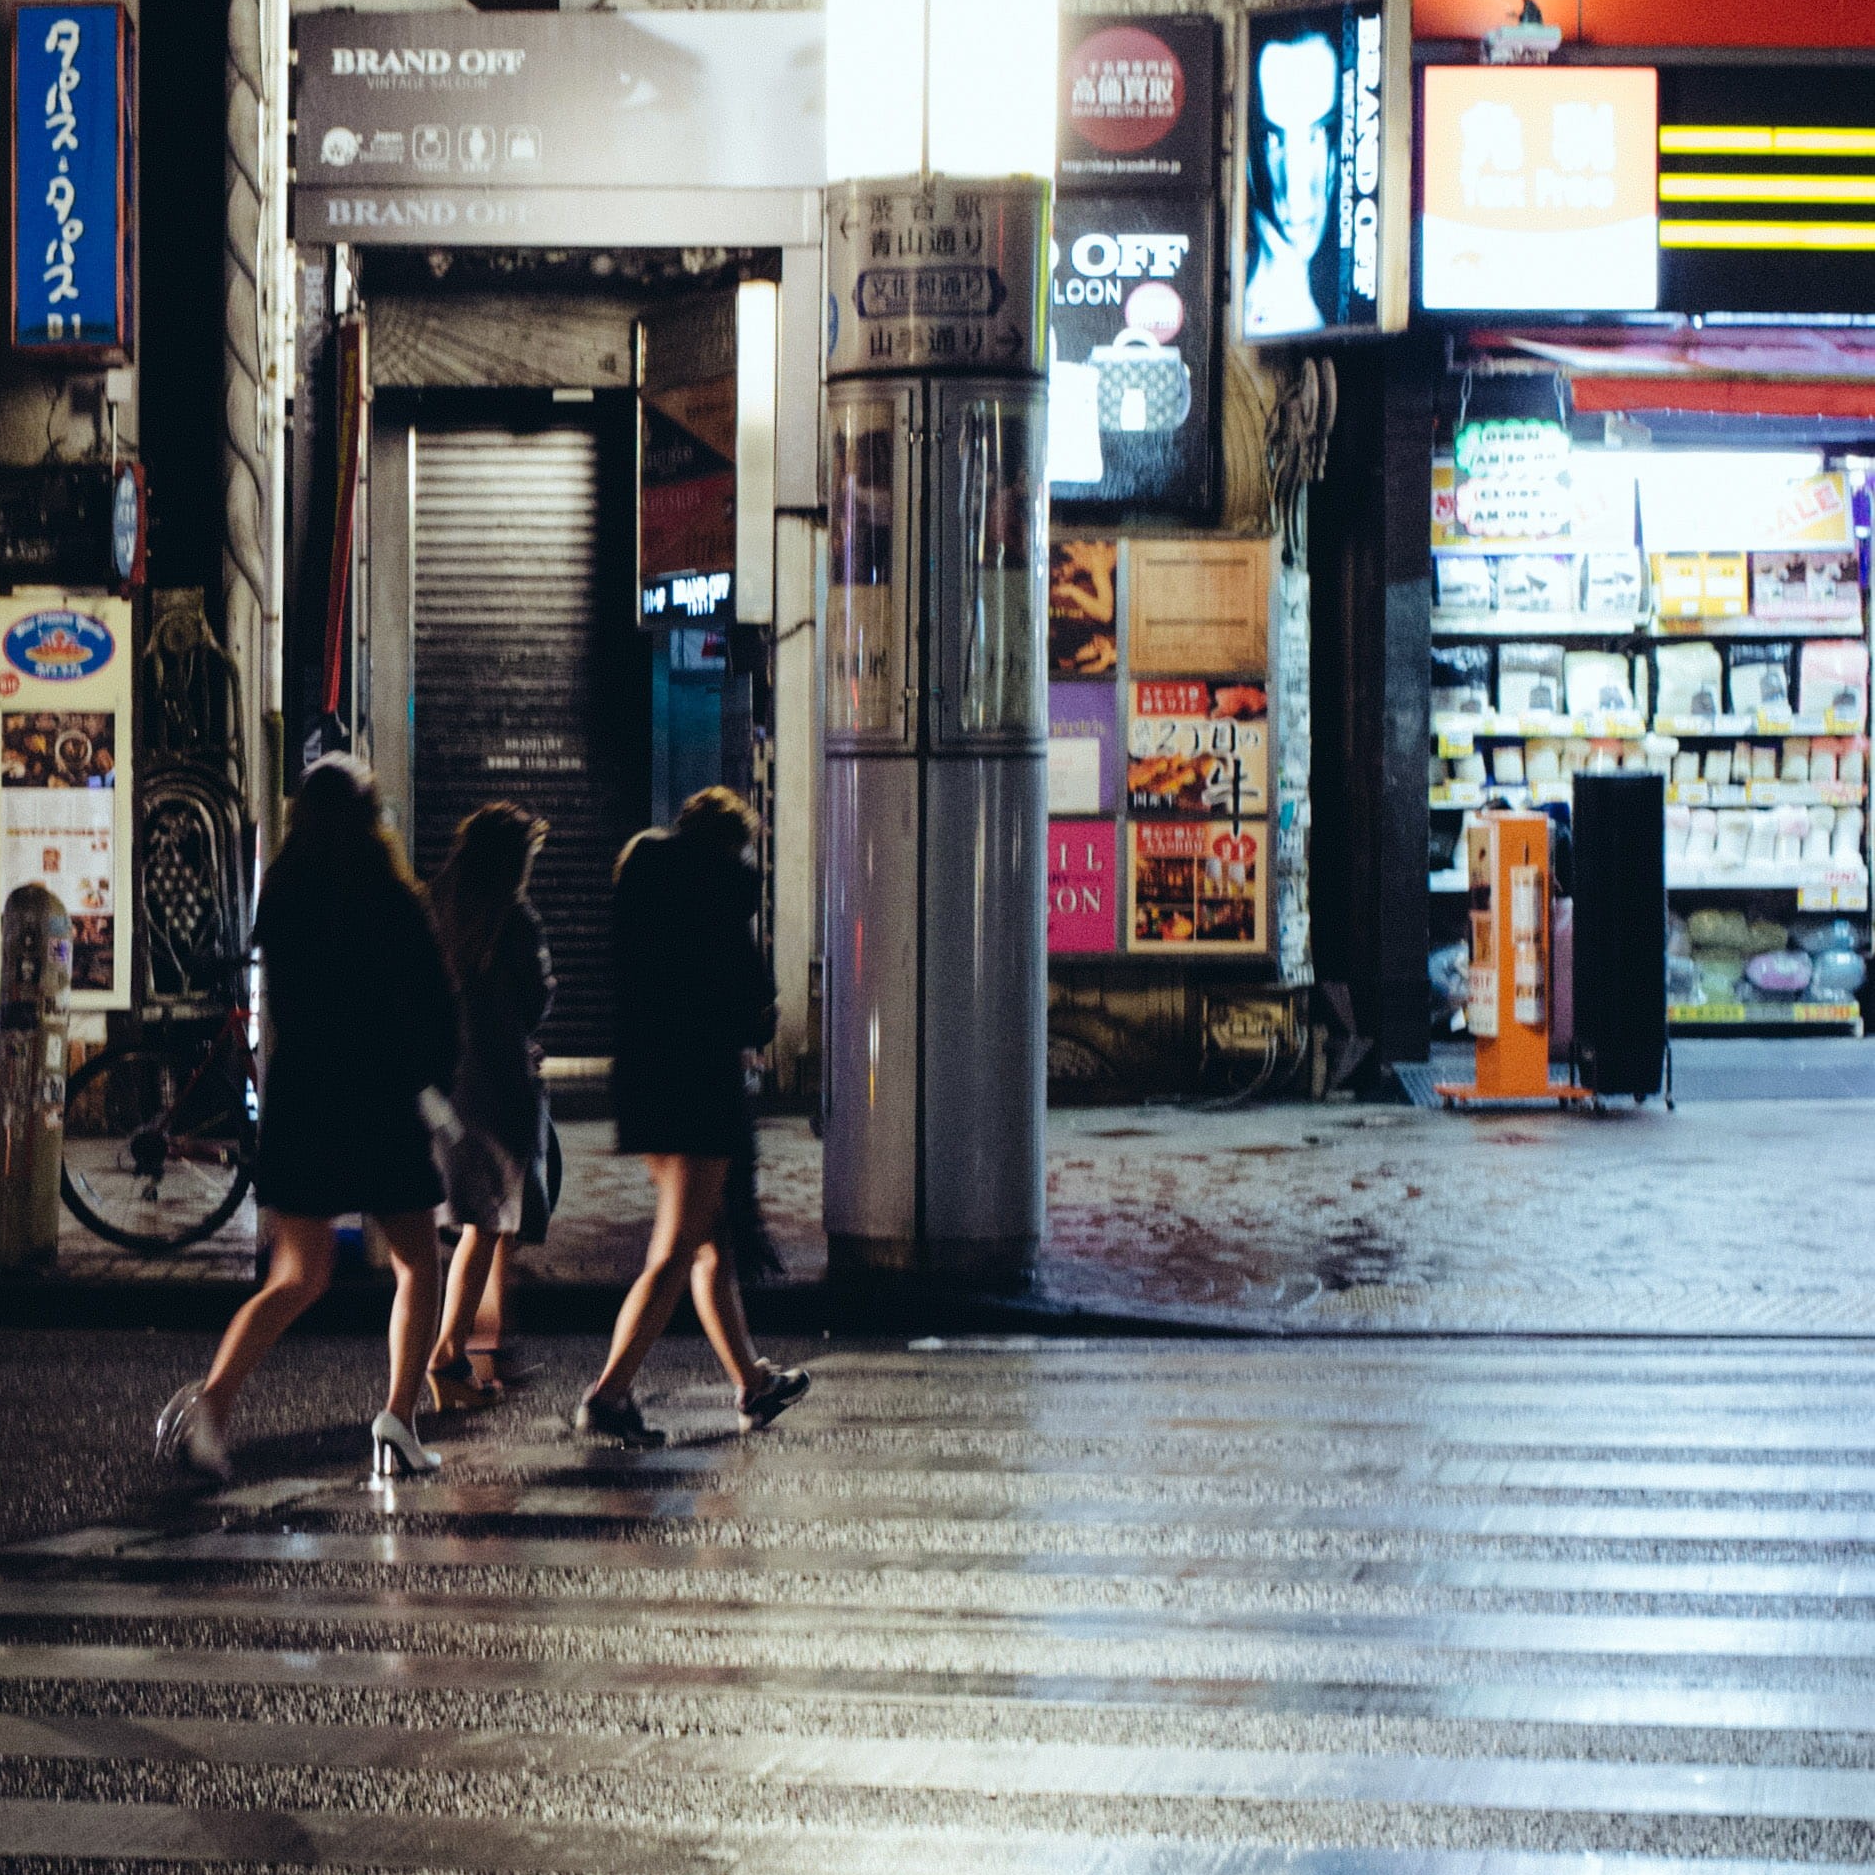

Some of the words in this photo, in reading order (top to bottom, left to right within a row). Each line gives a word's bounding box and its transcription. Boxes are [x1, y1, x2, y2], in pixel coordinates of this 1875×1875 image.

[331, 49, 450, 75] BRAND
[459, 49, 524, 75] OFF
[367, 74, 426, 90] VINTAGE
[429, 74, 488, 90] SALOON
[1071, 77, 1175, 106] 高価買取
[327, 198, 456, 227] BRAND
[871, 226, 983, 258] 青山通り
[1071, 233, 1189, 278] OFF
[1054, 279, 1122, 306] LOON
[1059, 842, 1103, 871] IL
